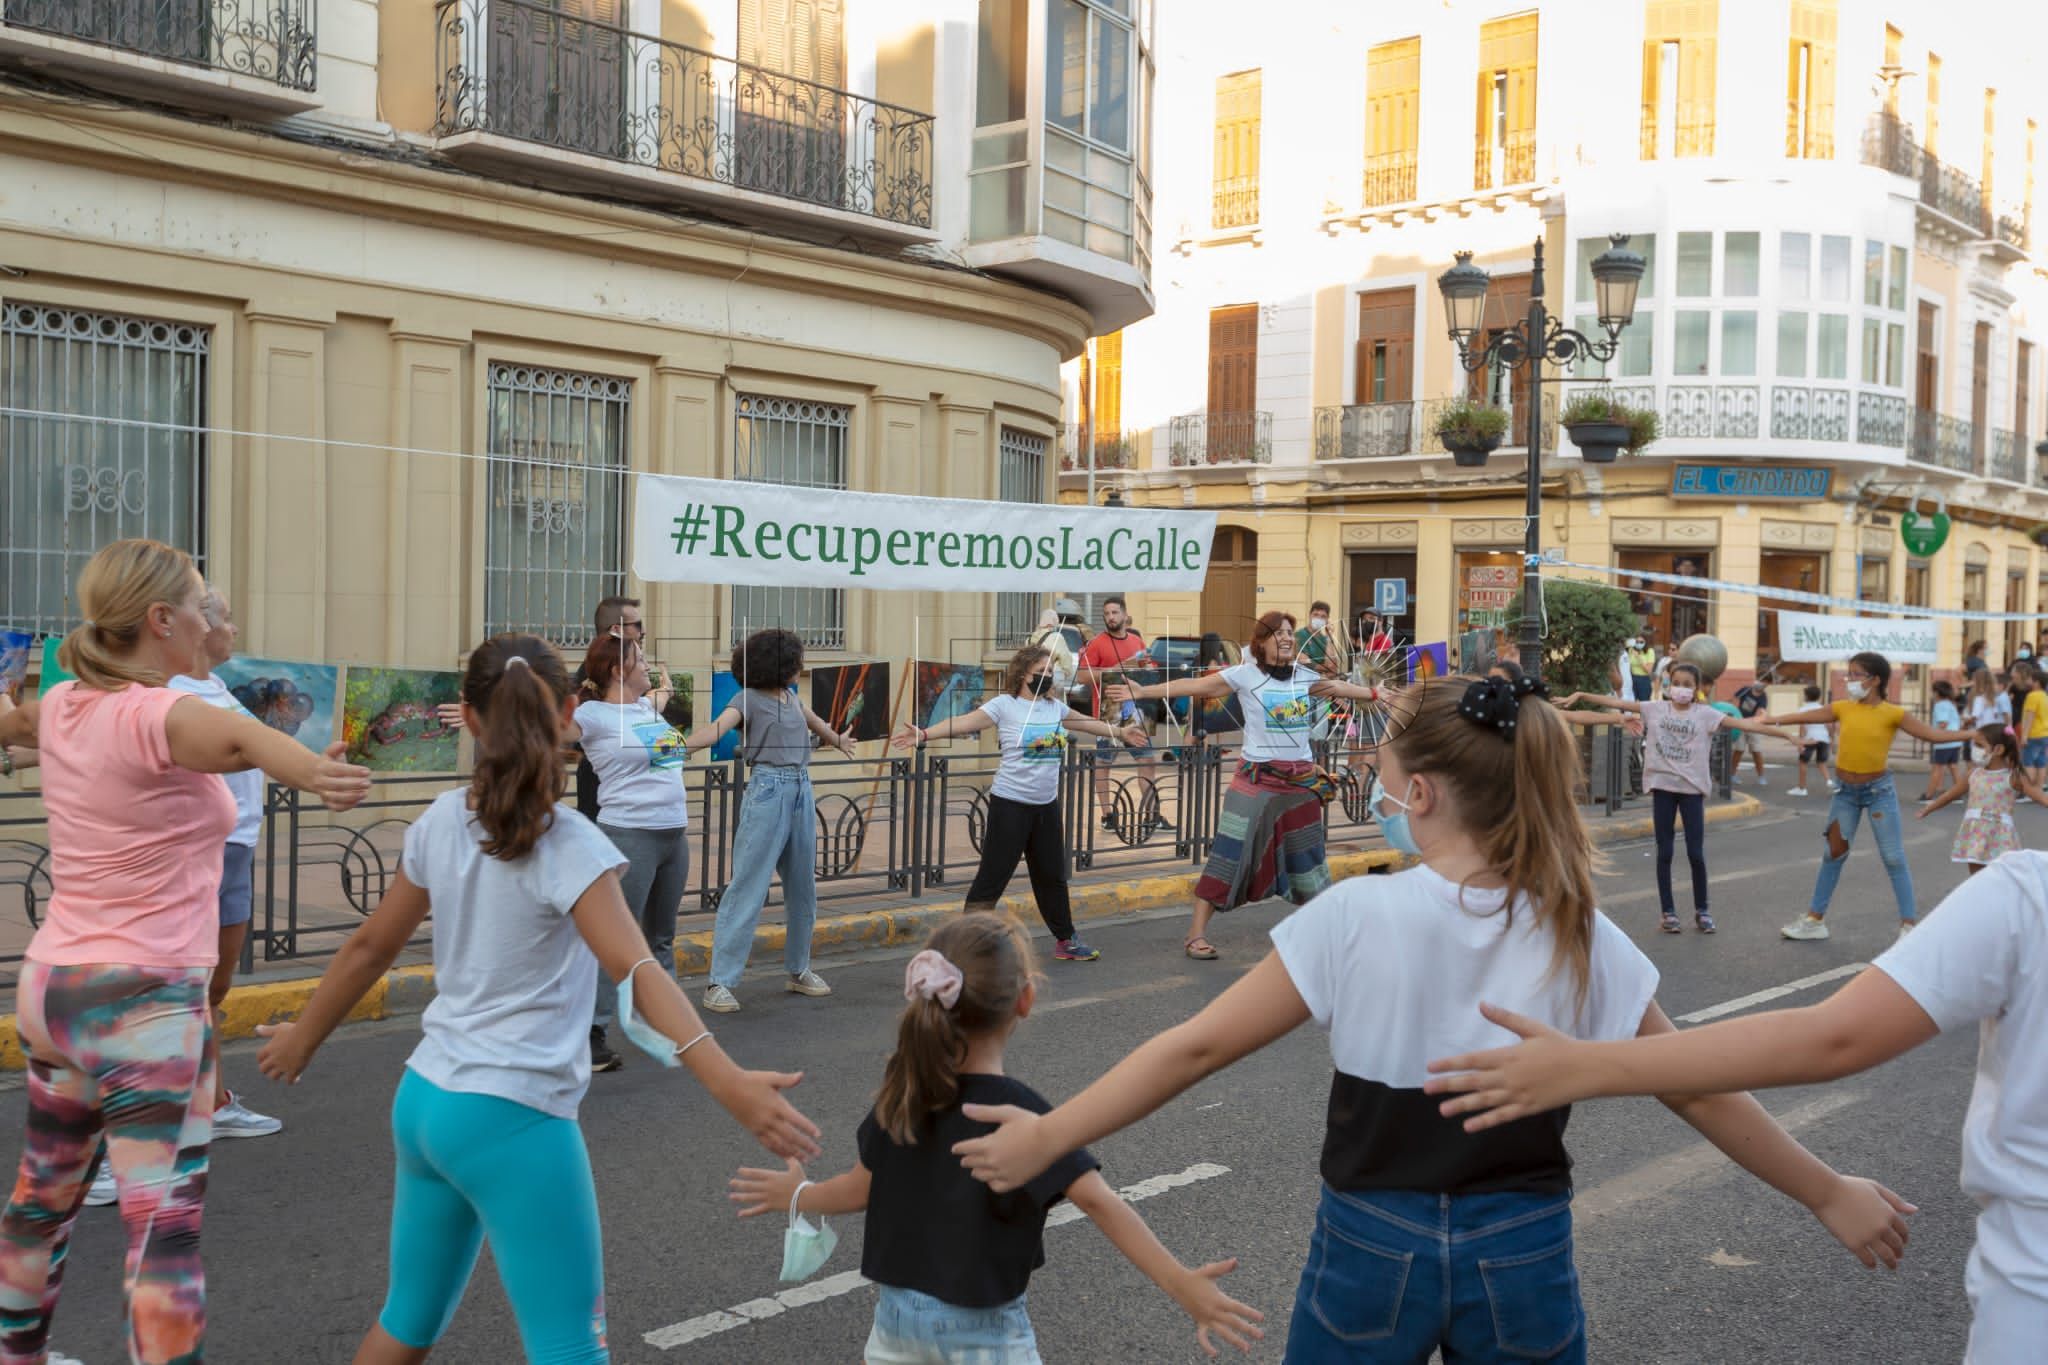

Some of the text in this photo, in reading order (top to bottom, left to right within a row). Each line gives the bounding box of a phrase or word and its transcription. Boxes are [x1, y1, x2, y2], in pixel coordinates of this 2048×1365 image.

[1678, 467, 1826, 495] EL CANDADO
[671, 502, 1201, 575] #RecuperemosLaCalle
[1383, 582, 1397, 611] P
